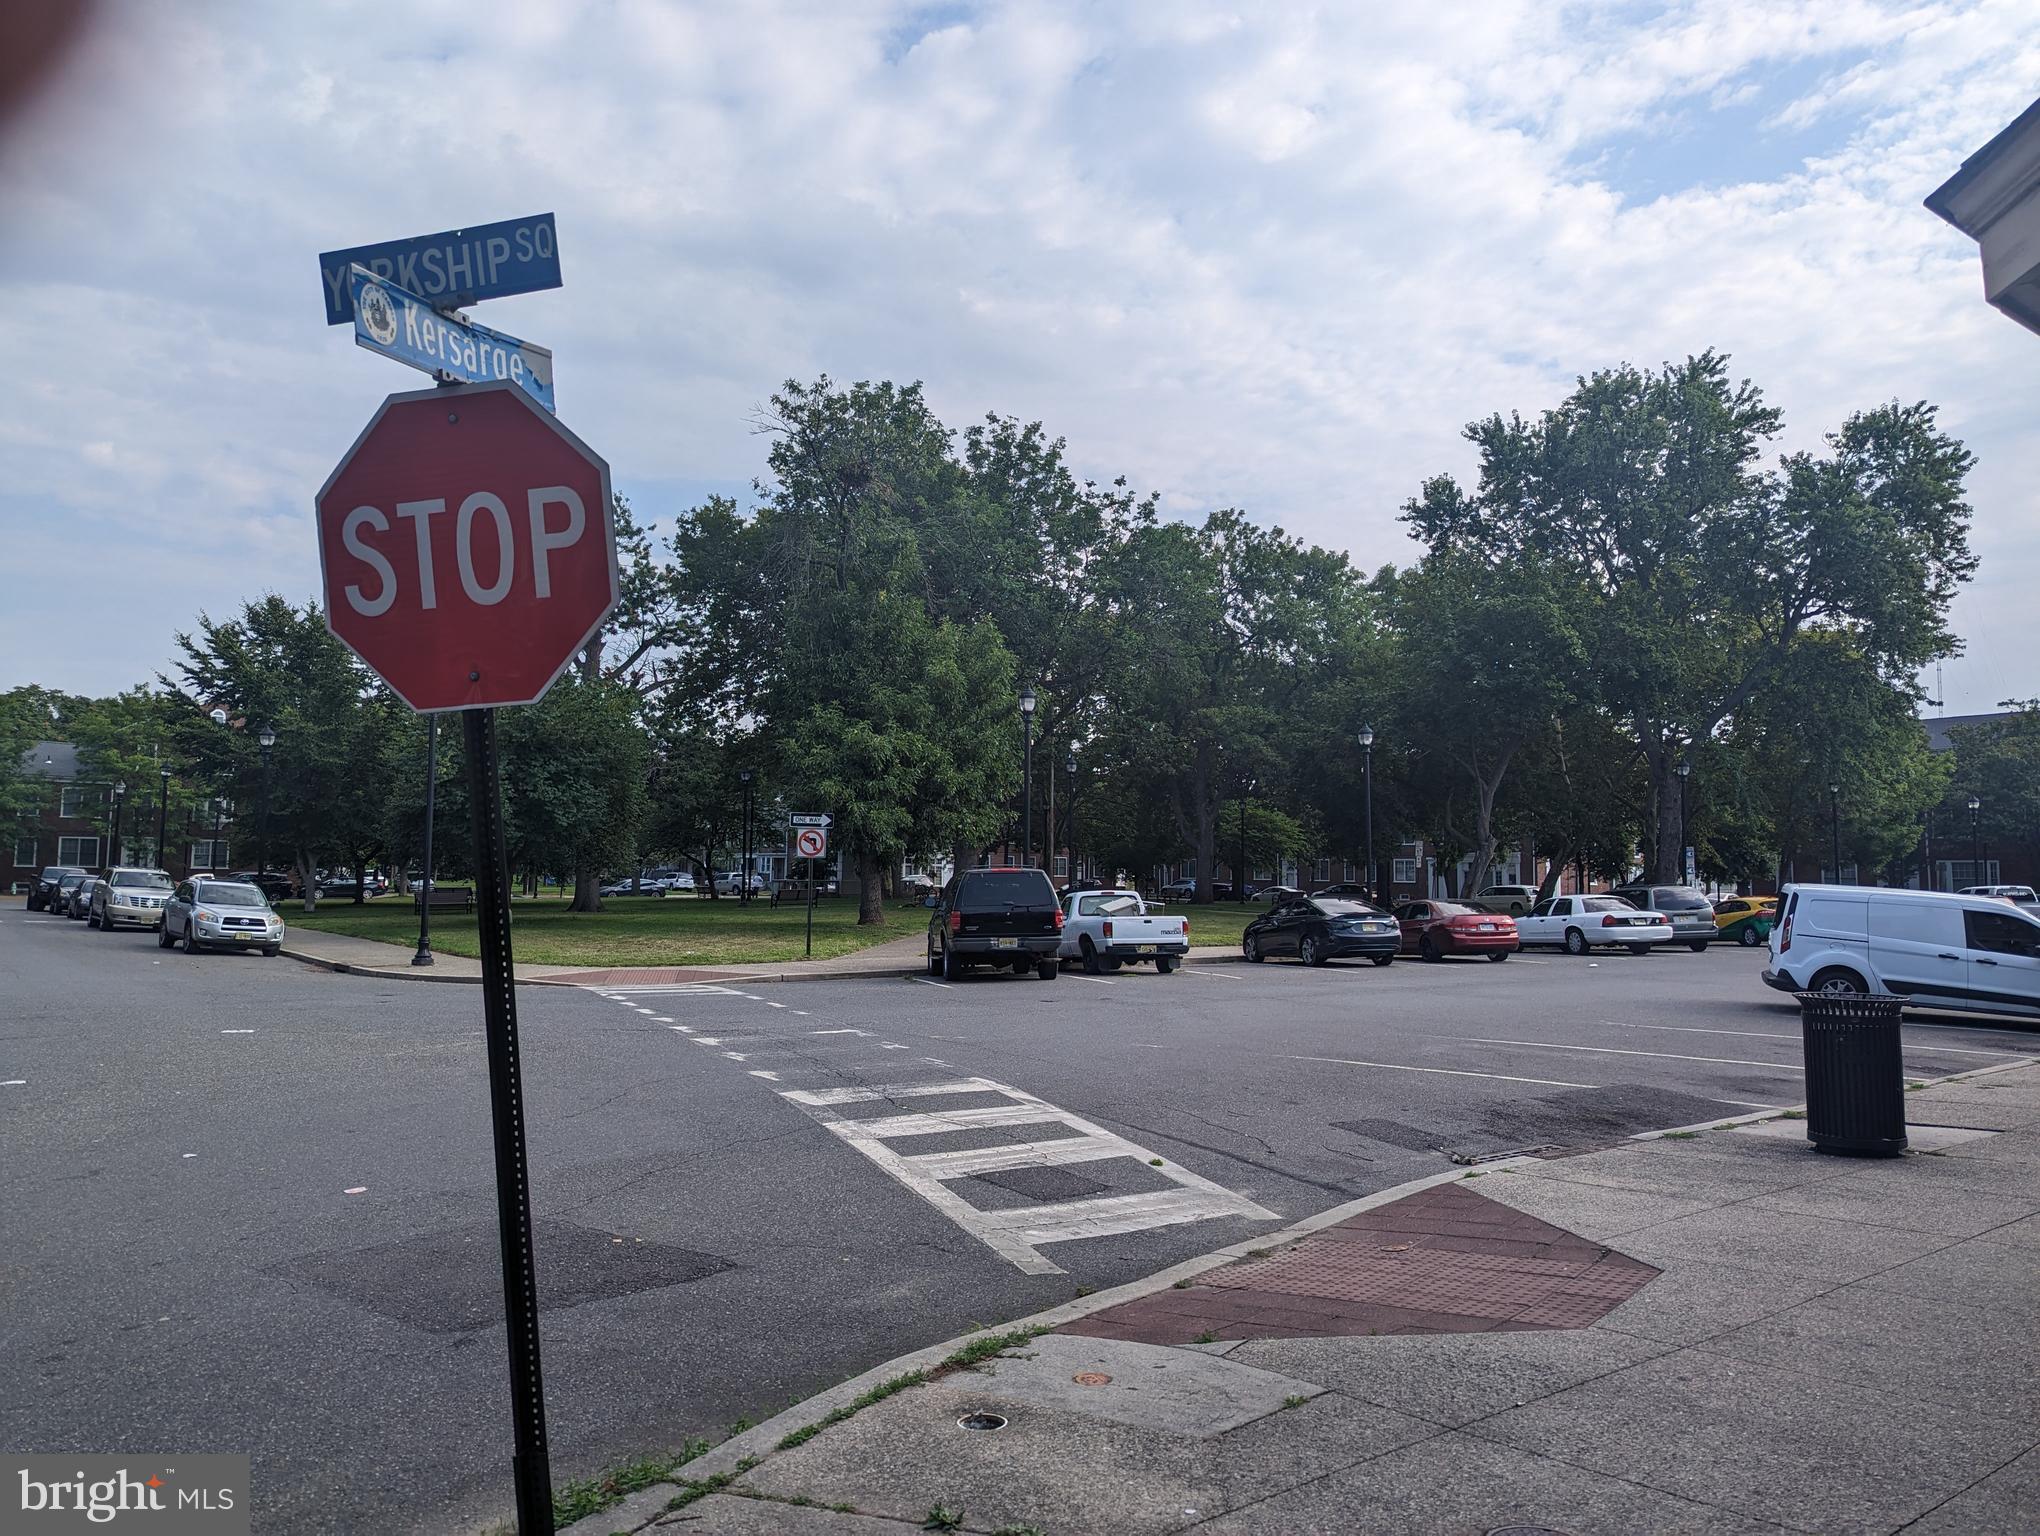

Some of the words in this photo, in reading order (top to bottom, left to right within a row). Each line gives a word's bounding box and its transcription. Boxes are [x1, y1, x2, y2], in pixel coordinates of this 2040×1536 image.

[323, 237, 510, 313] YKSHIP
[514, 222, 553, 264] SQ
[342, 485, 586, 617] STOP
